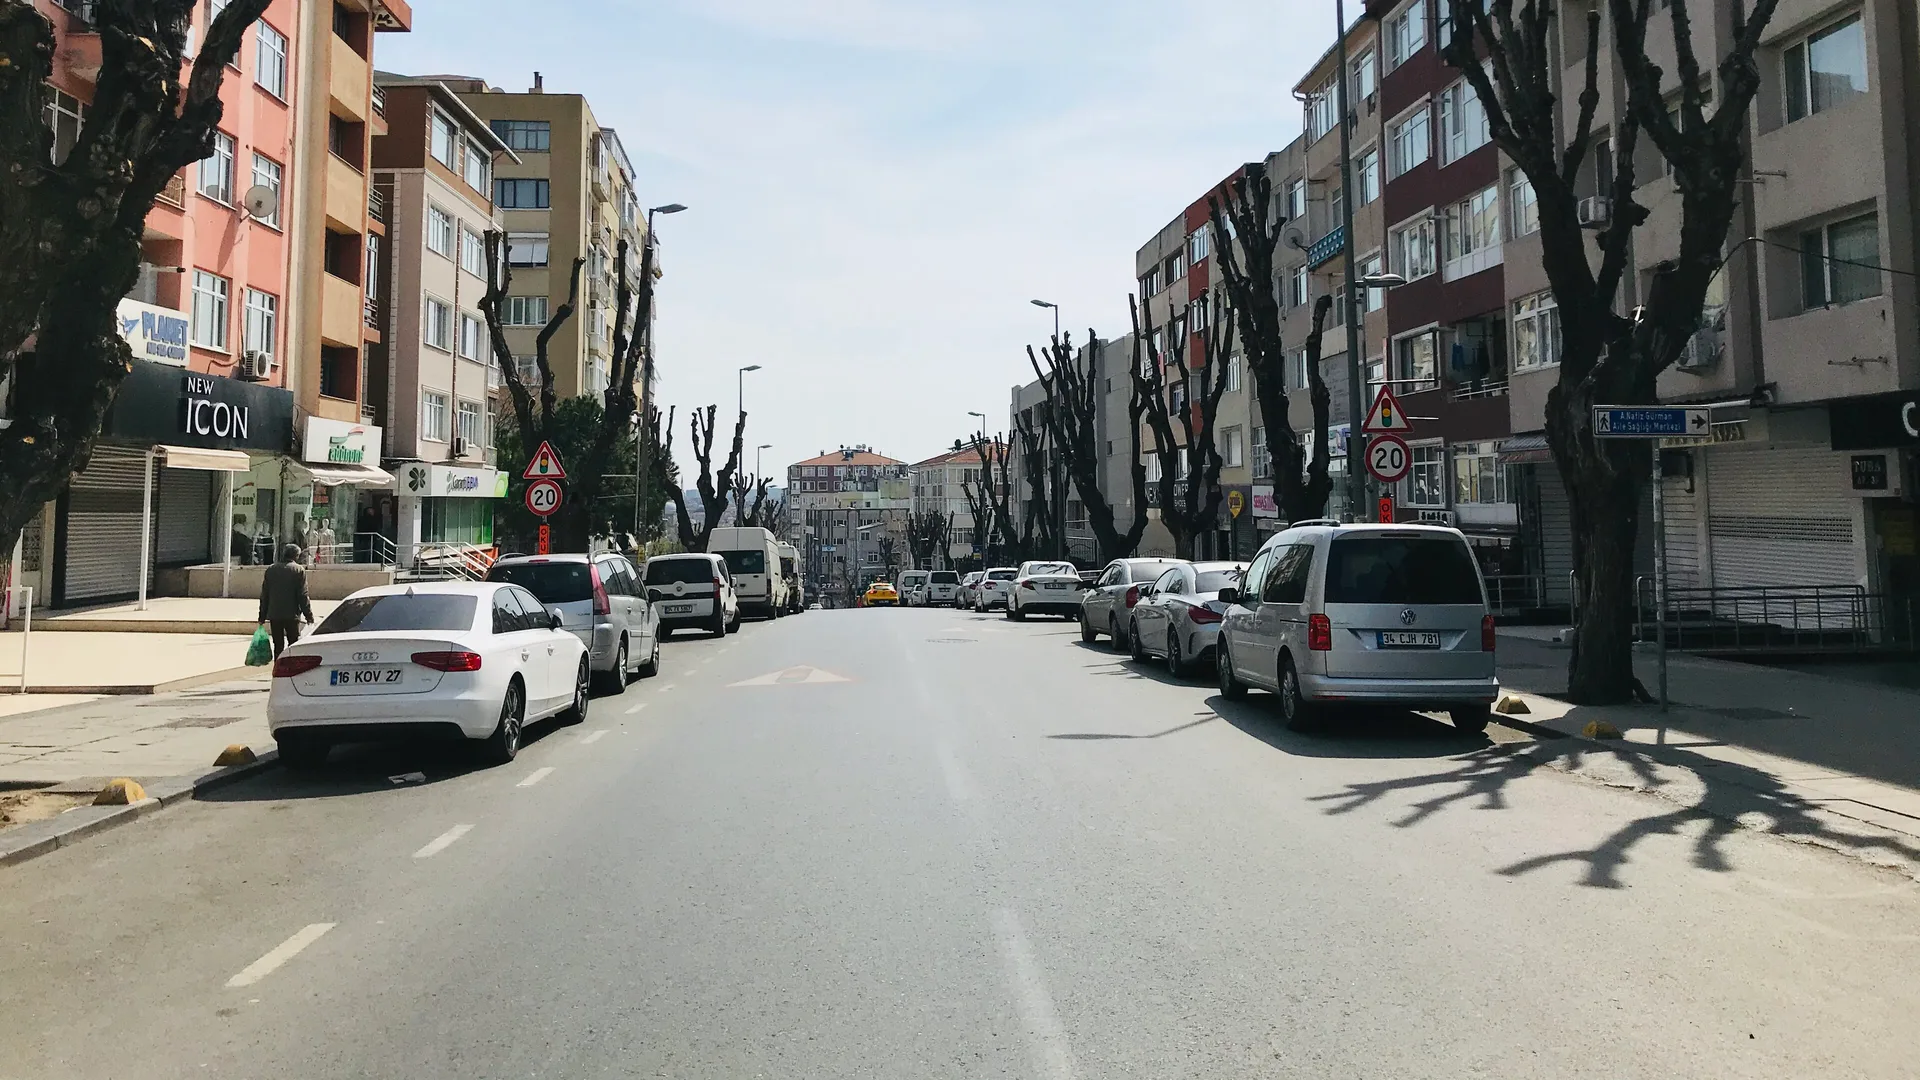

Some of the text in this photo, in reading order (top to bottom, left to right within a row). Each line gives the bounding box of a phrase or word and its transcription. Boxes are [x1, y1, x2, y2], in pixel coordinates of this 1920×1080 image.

[142, 311, 188, 347] PLANET
[188, 377, 214, 395] NEW
[186, 397, 248, 439] ICON
[1613, 422, 1626, 431] Aile
[1653, 422, 1681, 431] Merkezi
[1375, 447, 1403, 469] 20
[535, 489, 555, 506] 20
[1384, 633, 1438, 644] 34 CJH 781
[338, 670, 401, 683] 16 KOV 27
